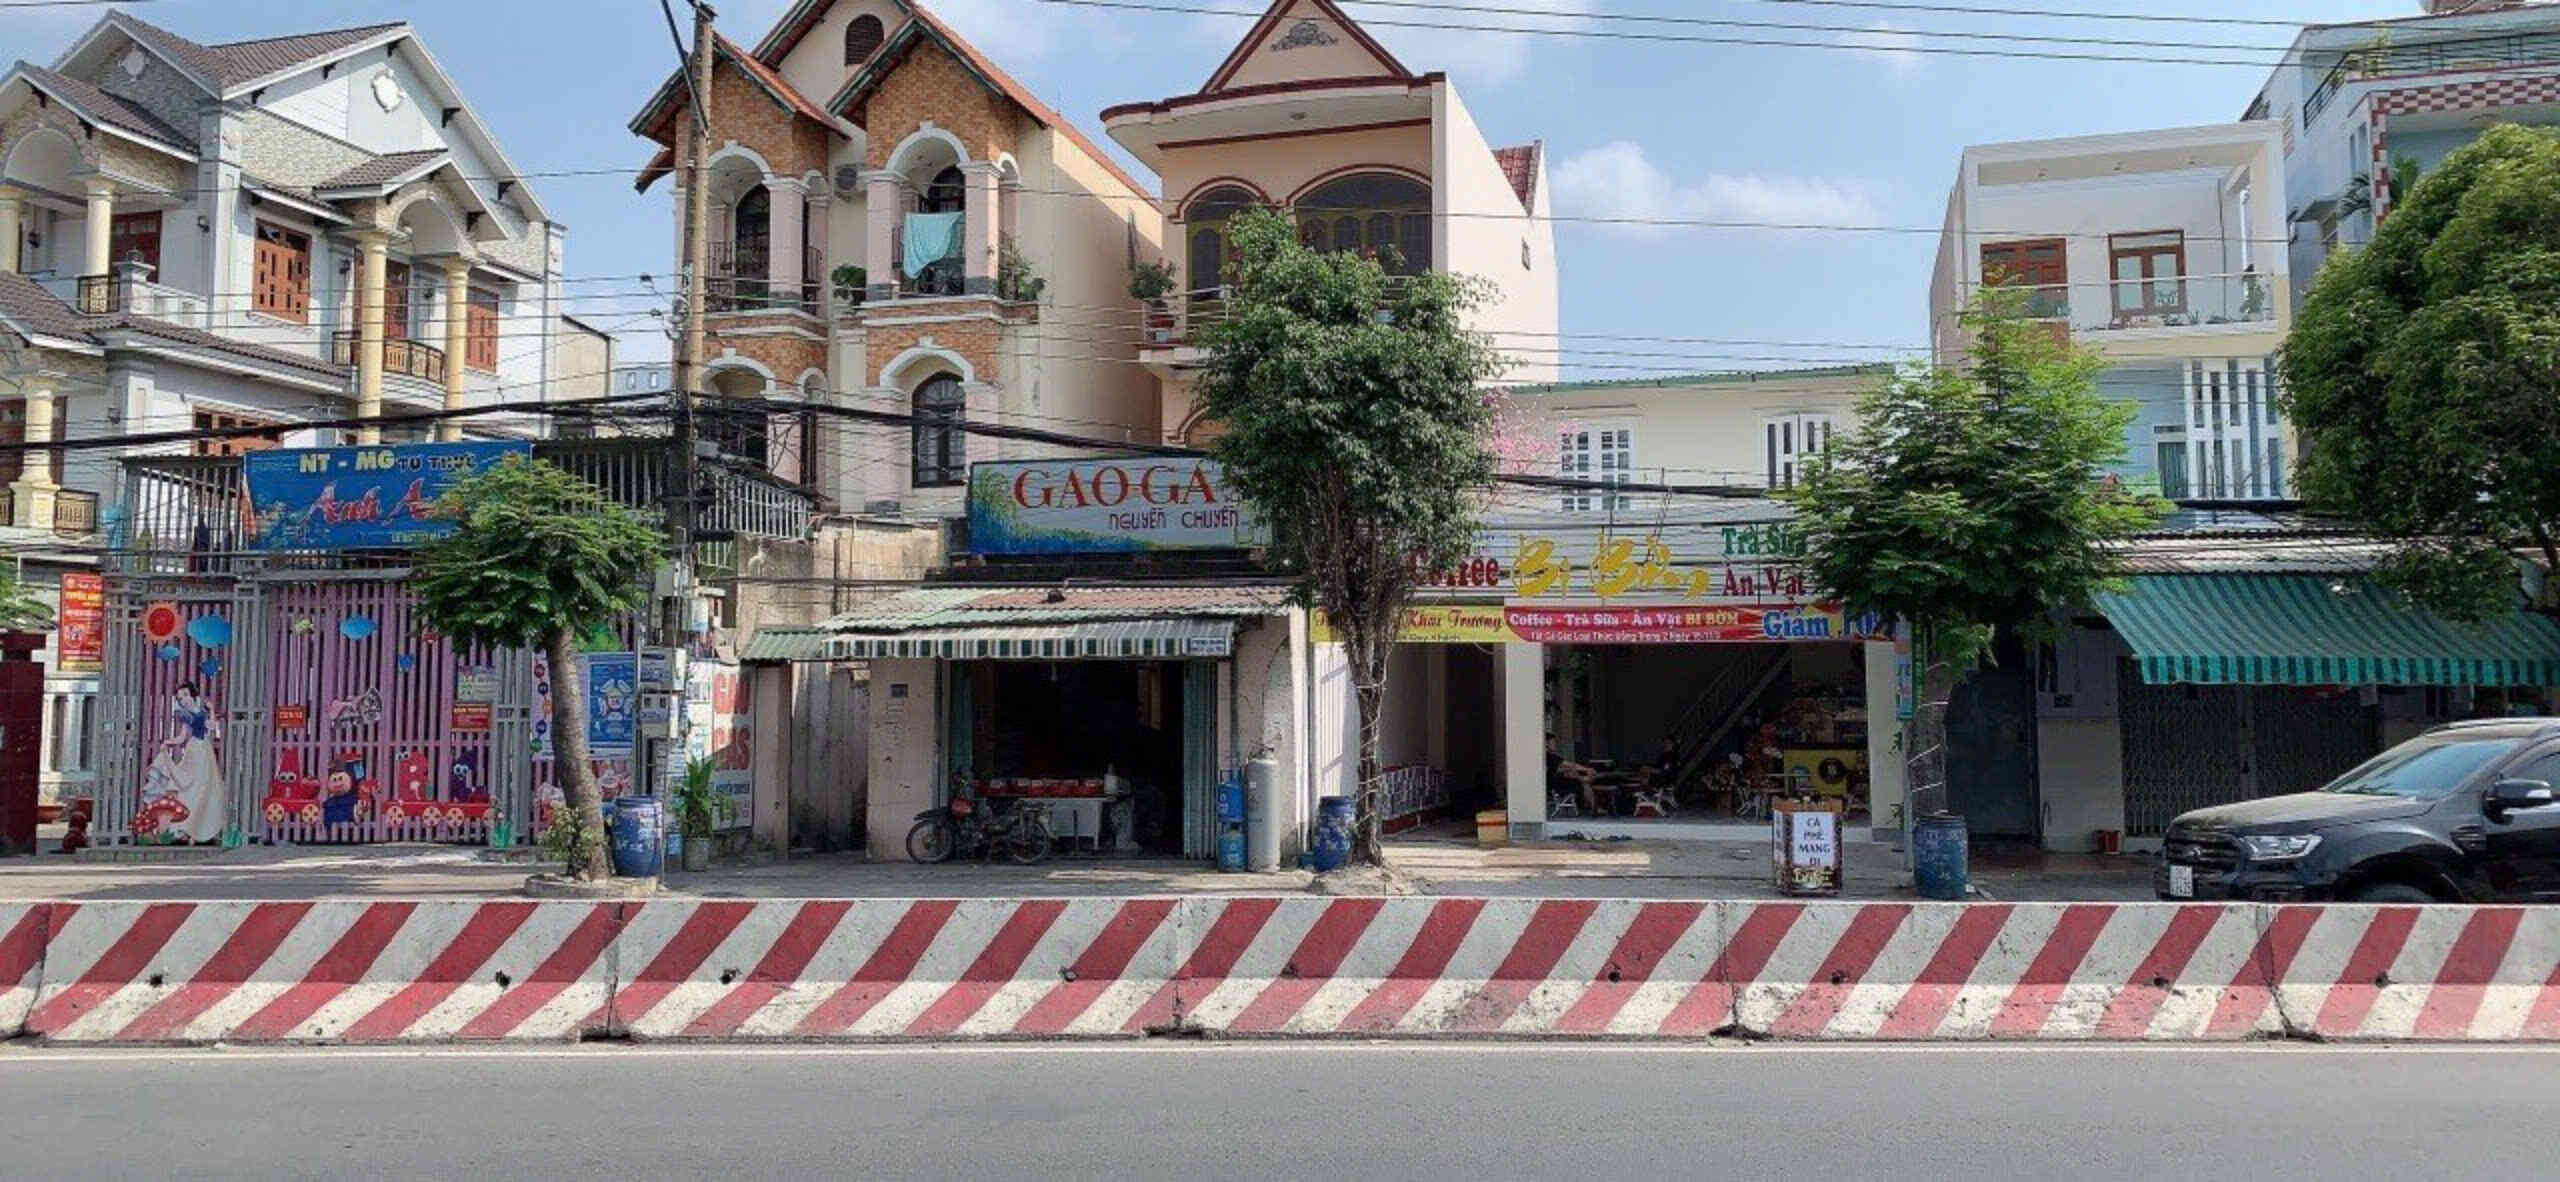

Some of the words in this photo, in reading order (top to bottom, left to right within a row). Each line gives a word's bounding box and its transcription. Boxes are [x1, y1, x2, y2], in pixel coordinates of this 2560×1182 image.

[300, 453, 331, 473] NT
[355, 449, 395, 471] MG
[1510, 613, 1554, 626] Coffee
[1763, 606, 1830, 638] Giảm
